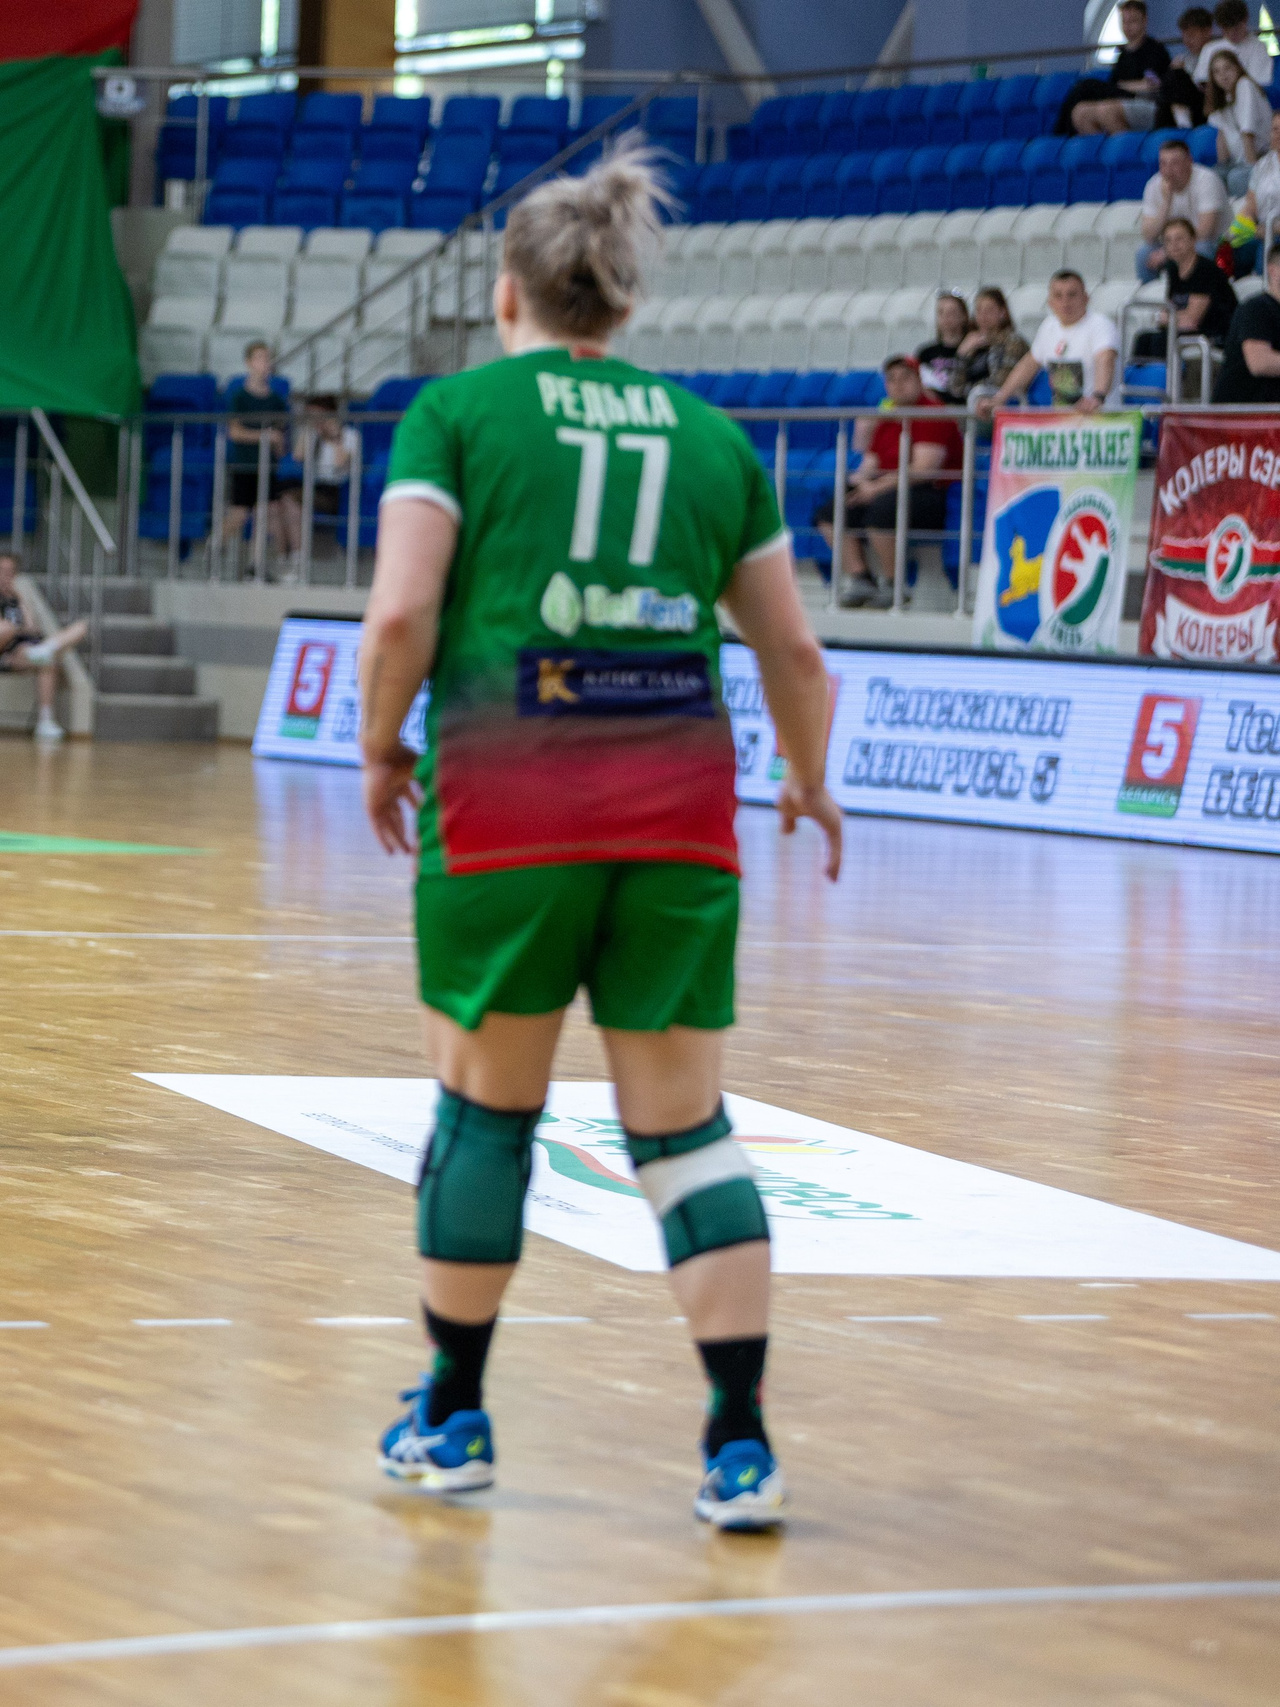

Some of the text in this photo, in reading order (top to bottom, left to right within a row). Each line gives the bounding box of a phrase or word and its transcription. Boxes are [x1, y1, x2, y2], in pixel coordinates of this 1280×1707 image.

[536, 371, 679, 430] РЕДЬКА
[556, 425, 670, 567] 77
[1159, 442, 1247, 516] КОЛЕРЫ
[1175, 616, 1254, 656] КОЛЕРЫ
[294, 646, 328, 711] 5
[864, 676, 1071, 738] Телеканал
[842, 736, 1061, 803] БЕЛАРУСЬ 5
[1140, 701, 1185, 780] 5
